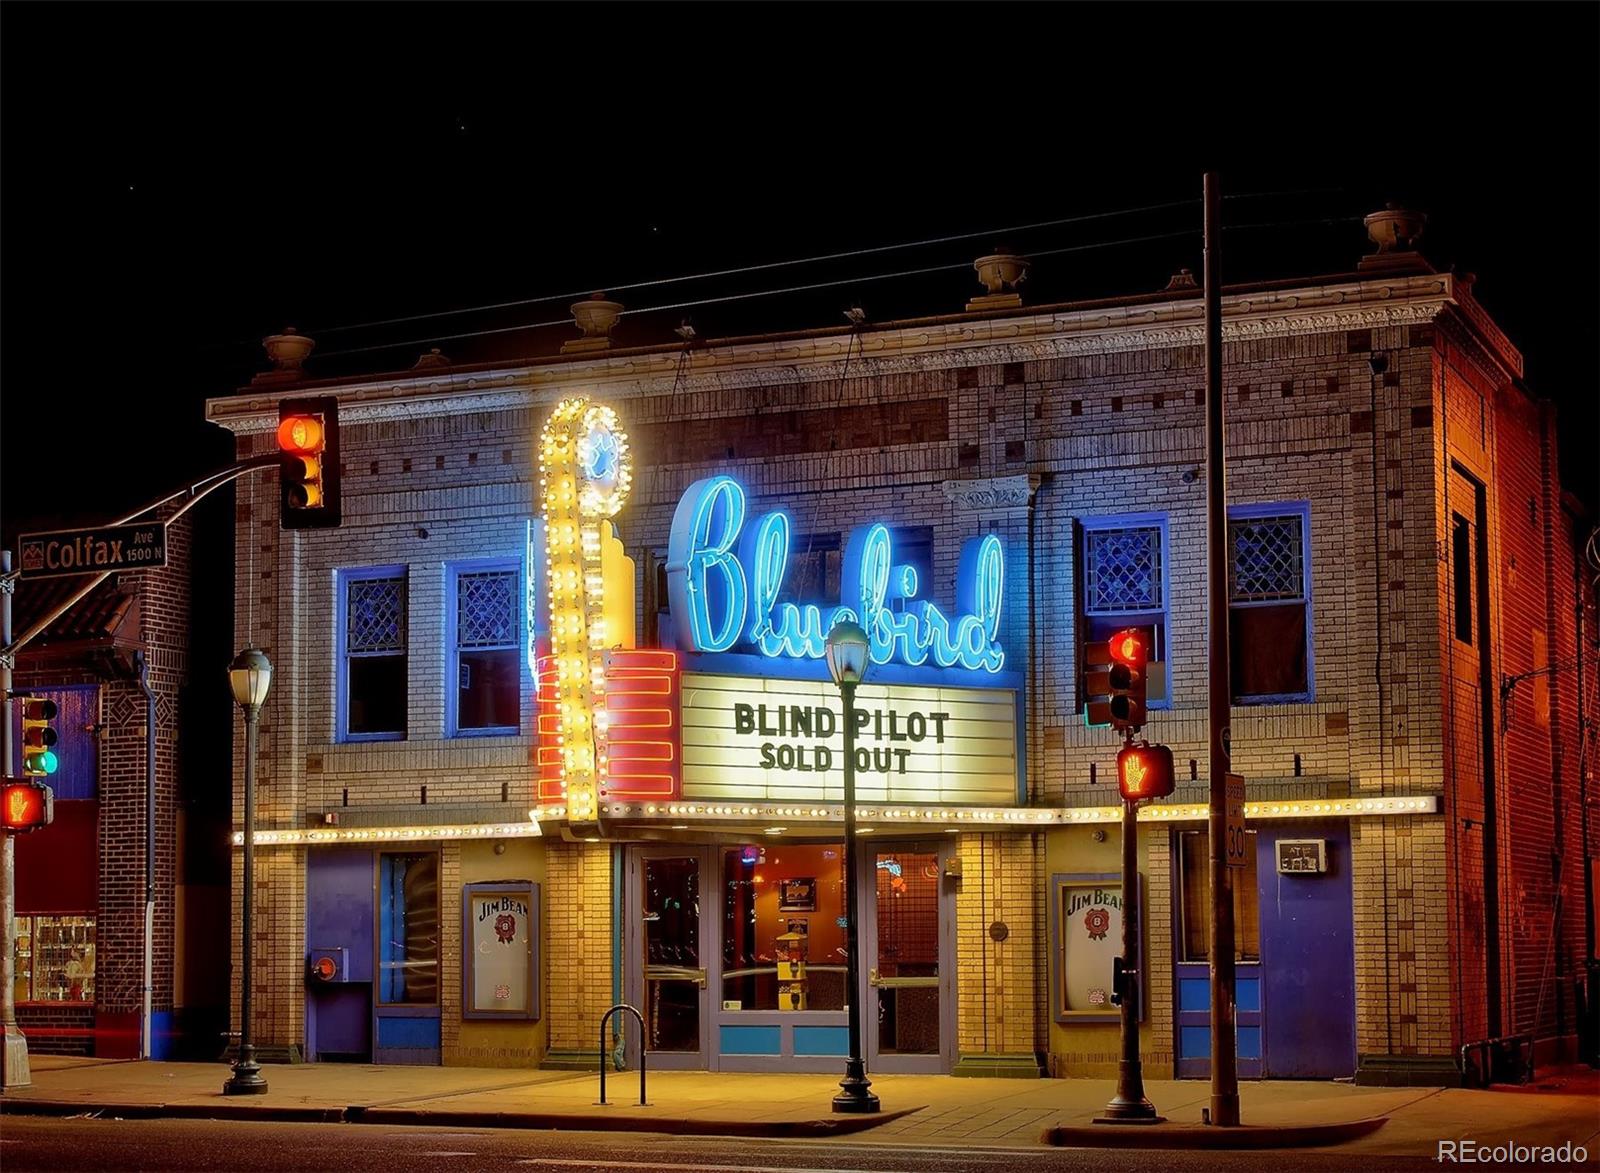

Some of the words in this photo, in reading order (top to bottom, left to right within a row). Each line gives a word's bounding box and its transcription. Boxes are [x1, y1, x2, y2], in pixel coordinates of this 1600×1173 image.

[46, 536, 123, 569] Colfax
[134, 531, 153, 544] Ave
[126, 548, 151, 562] 1500
[154, 547, 162, 559] N
[685, 475, 1005, 673] Blubird
[734, 703, 836, 739] BLIND
[853, 708, 950, 744] PILOT
[759, 742, 833, 772] SOLD
[854, 747, 911, 775] OUT
[1228, 824, 1244, 858] 30
[479, 901, 500, 921] JIM
[1067, 894, 1092, 916] JIM
